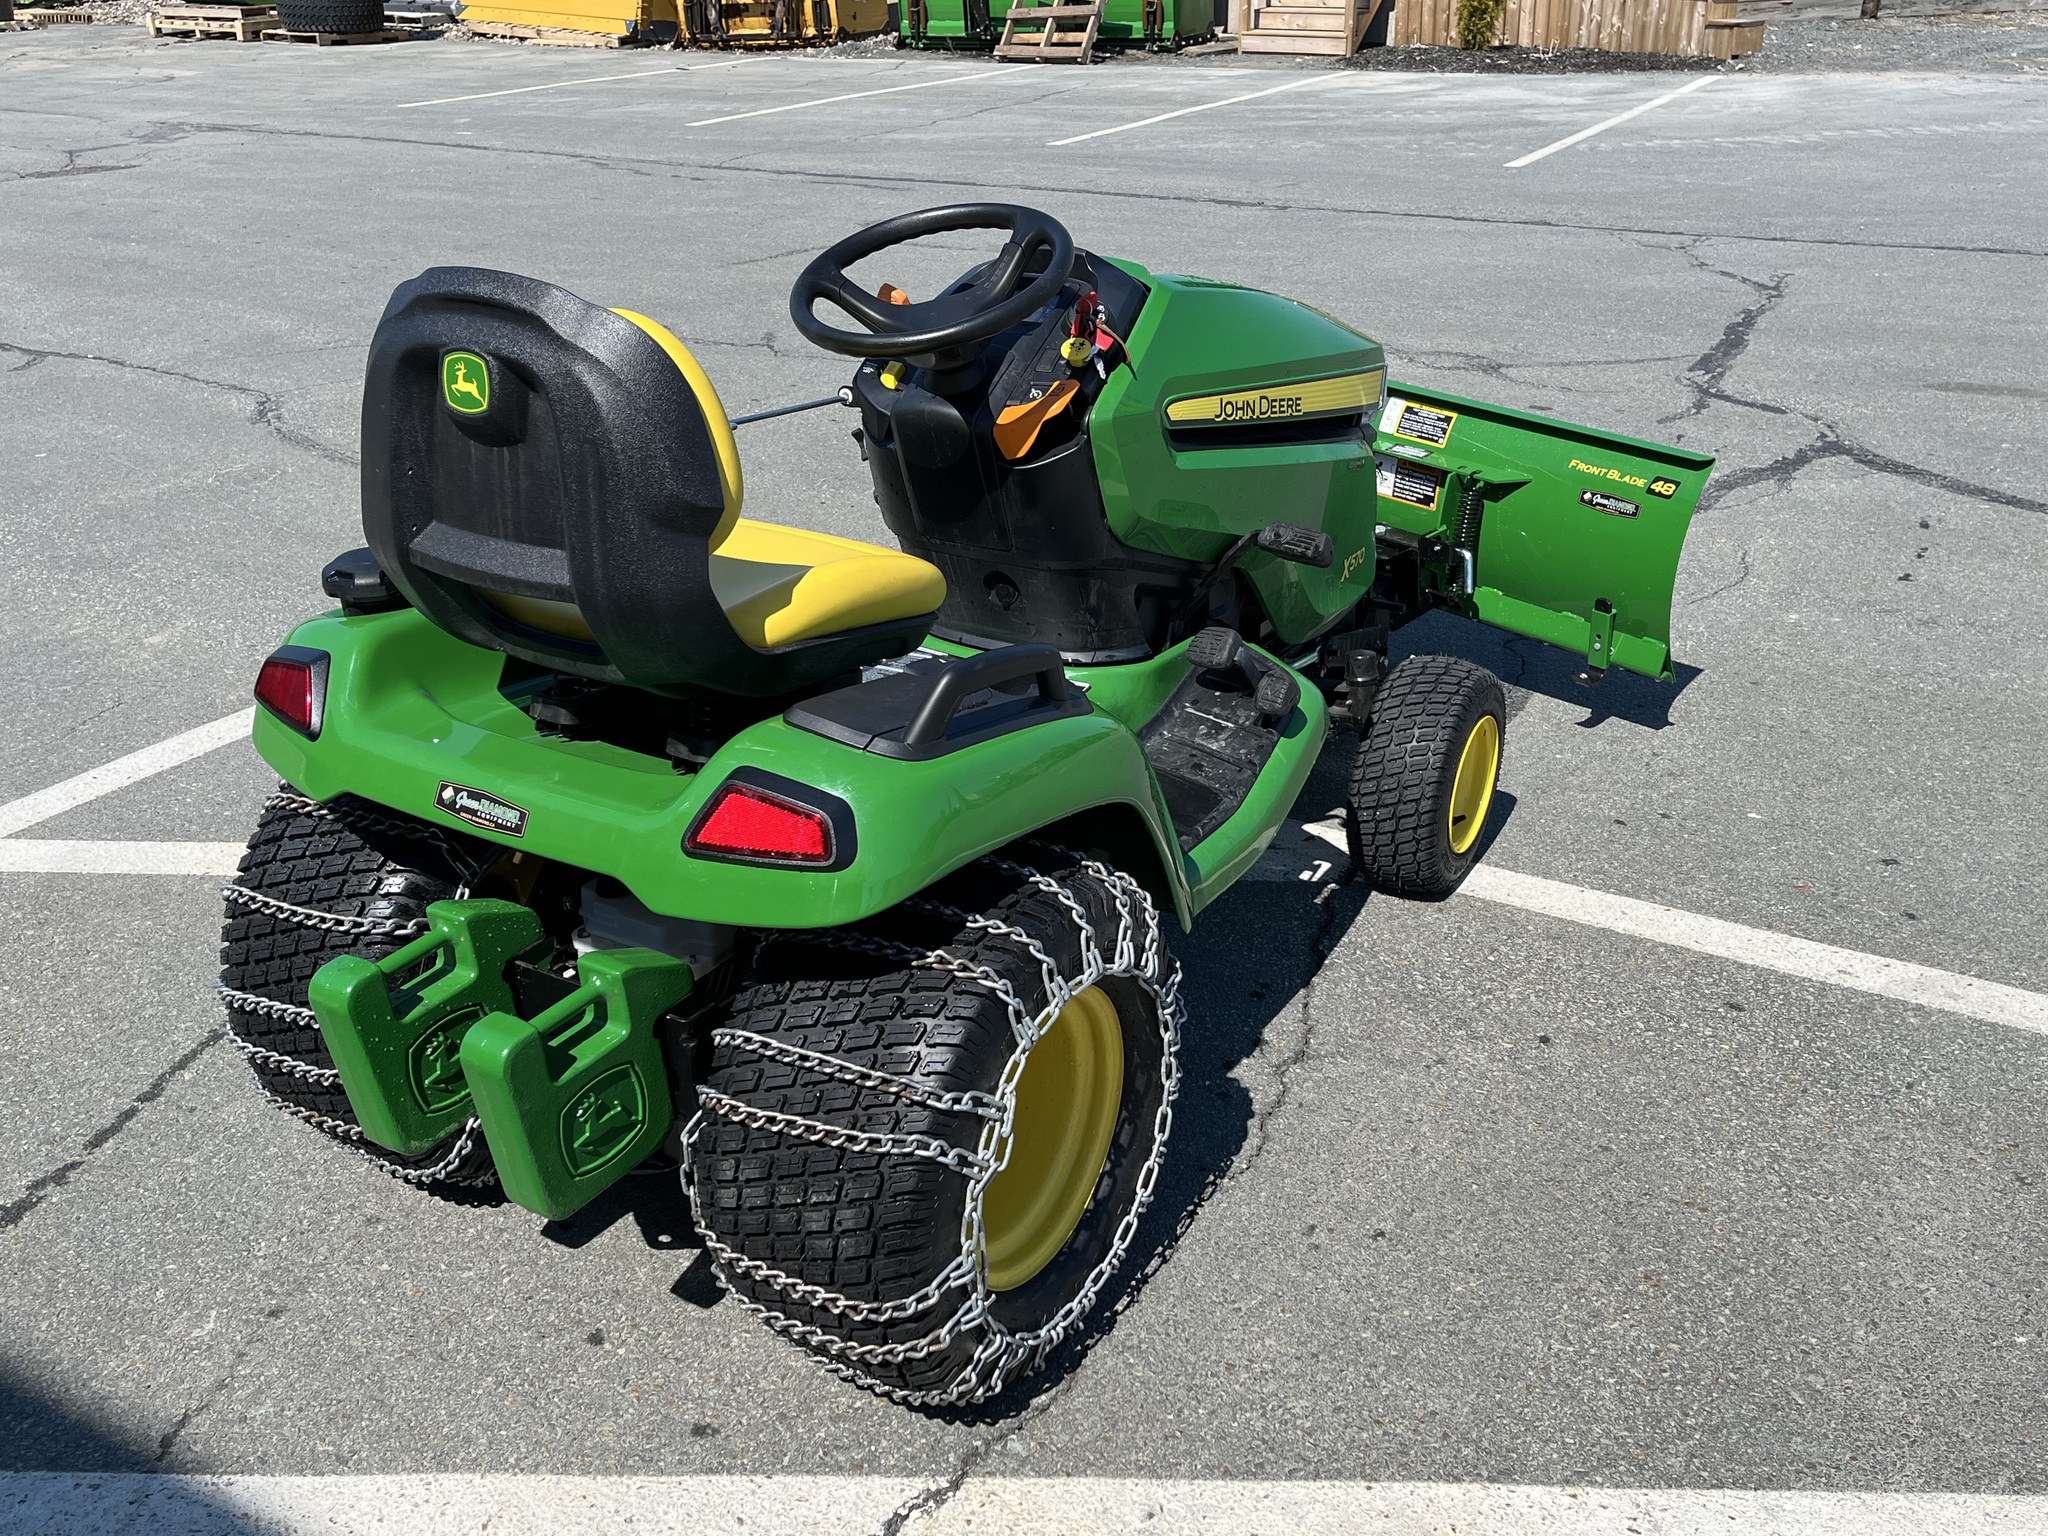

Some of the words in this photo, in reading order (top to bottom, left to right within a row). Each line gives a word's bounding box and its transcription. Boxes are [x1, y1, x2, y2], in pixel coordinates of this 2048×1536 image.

[1214, 397, 1256, 420] JOHN
[1259, 395, 1302, 417] DEERE
[1568, 459, 1608, 476] FRONT
[1606, 468, 1648, 487] BLADE
[1649, 480, 1677, 496] 48
[1340, 546, 1365, 582] X570
[477, 811, 516, 828] EQUIPMENT
[479, 798, 520, 823] DIAMOND
